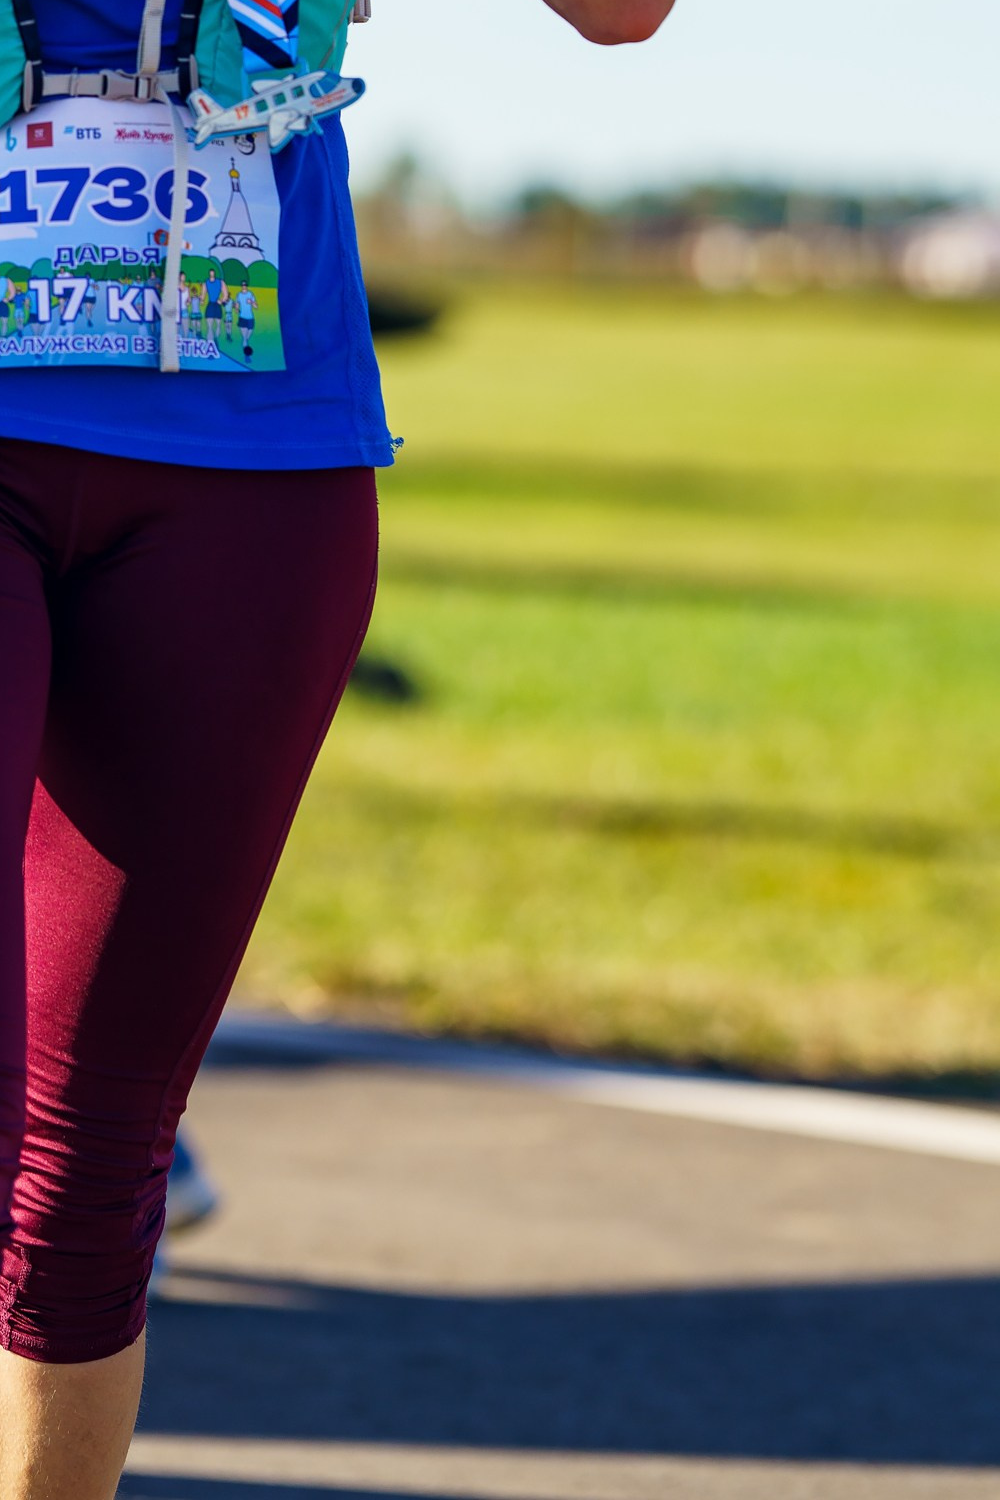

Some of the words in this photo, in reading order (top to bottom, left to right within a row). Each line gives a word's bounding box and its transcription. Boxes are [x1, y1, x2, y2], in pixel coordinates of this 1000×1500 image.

[76, 127, 101, 140] ВТБ
[53, 246, 161, 268] ДАРЬЯ
[29, 277, 89, 323] 17
[133, 337, 219, 359] ВЗТКА
